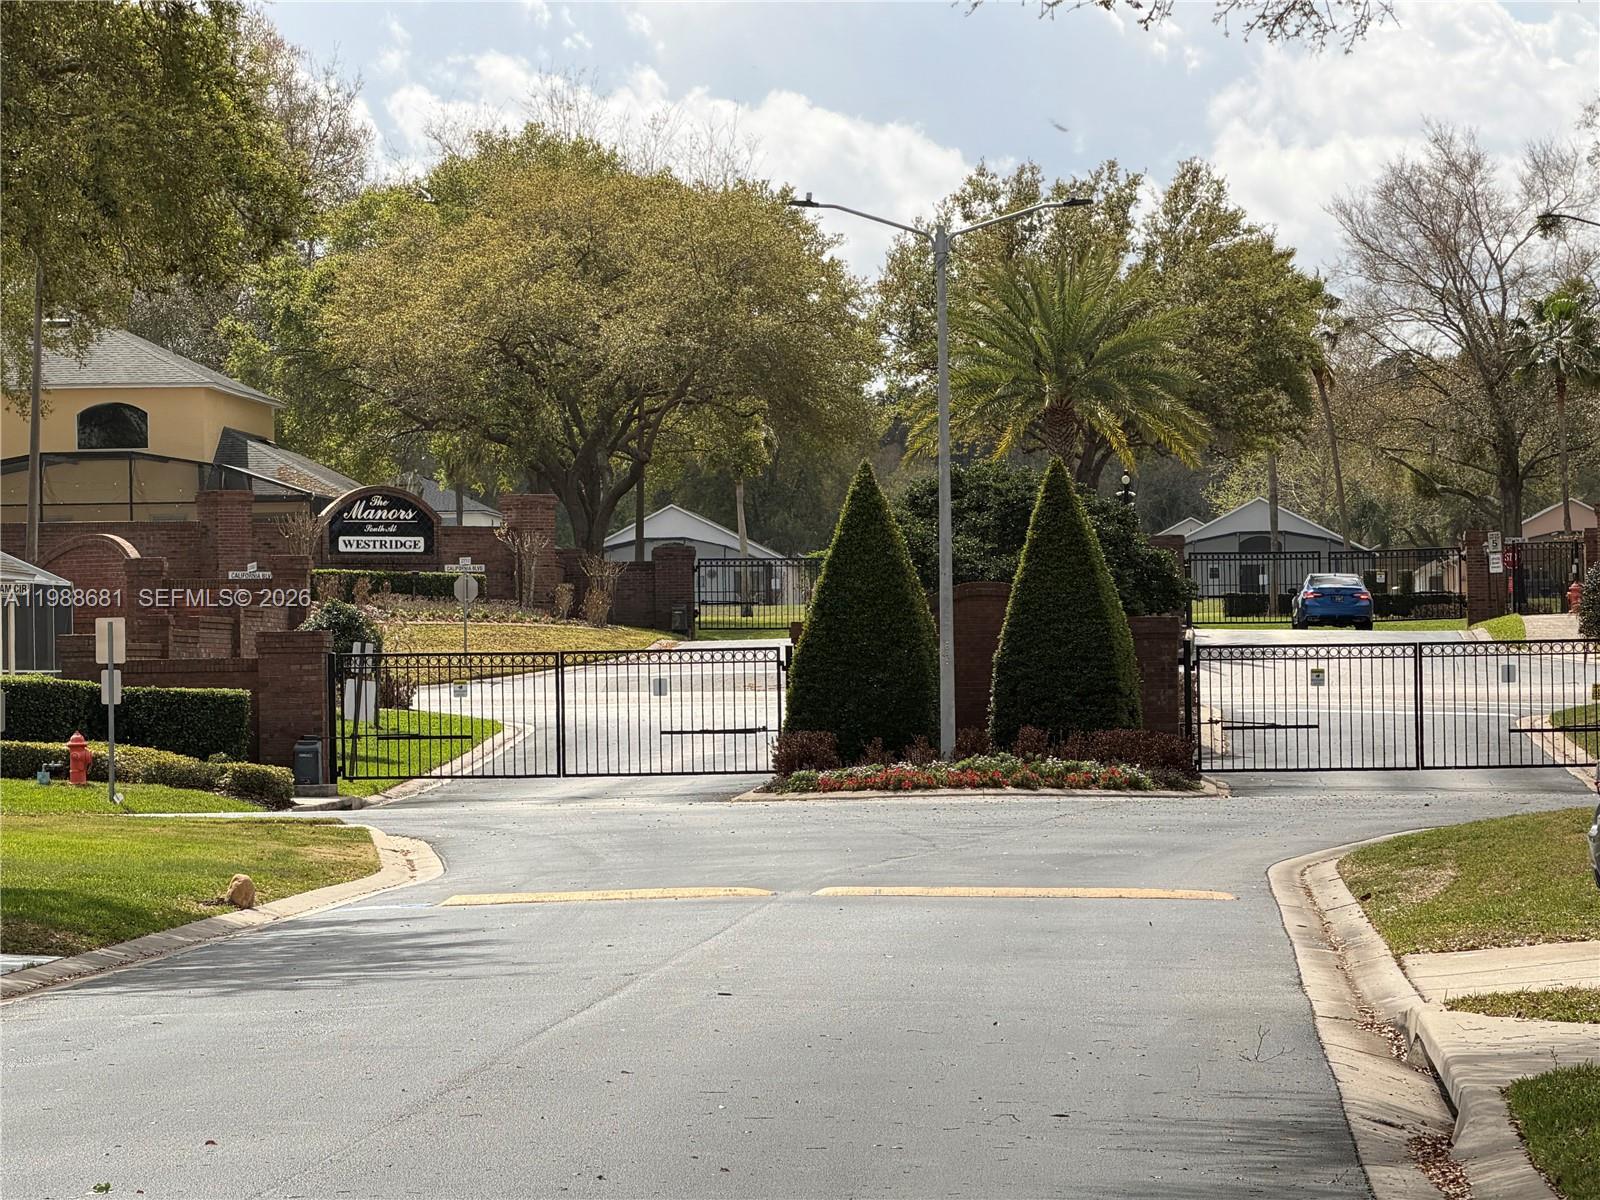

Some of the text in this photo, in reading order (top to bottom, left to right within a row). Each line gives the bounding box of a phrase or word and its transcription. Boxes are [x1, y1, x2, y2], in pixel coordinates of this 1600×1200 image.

[369, 496, 389, 506] The
[343, 500, 417, 520] Manors
[343, 540, 421, 550] WESTRIDGE
[1492, 539, 1498, 547] 5
[14, 584, 27, 593] CIR
